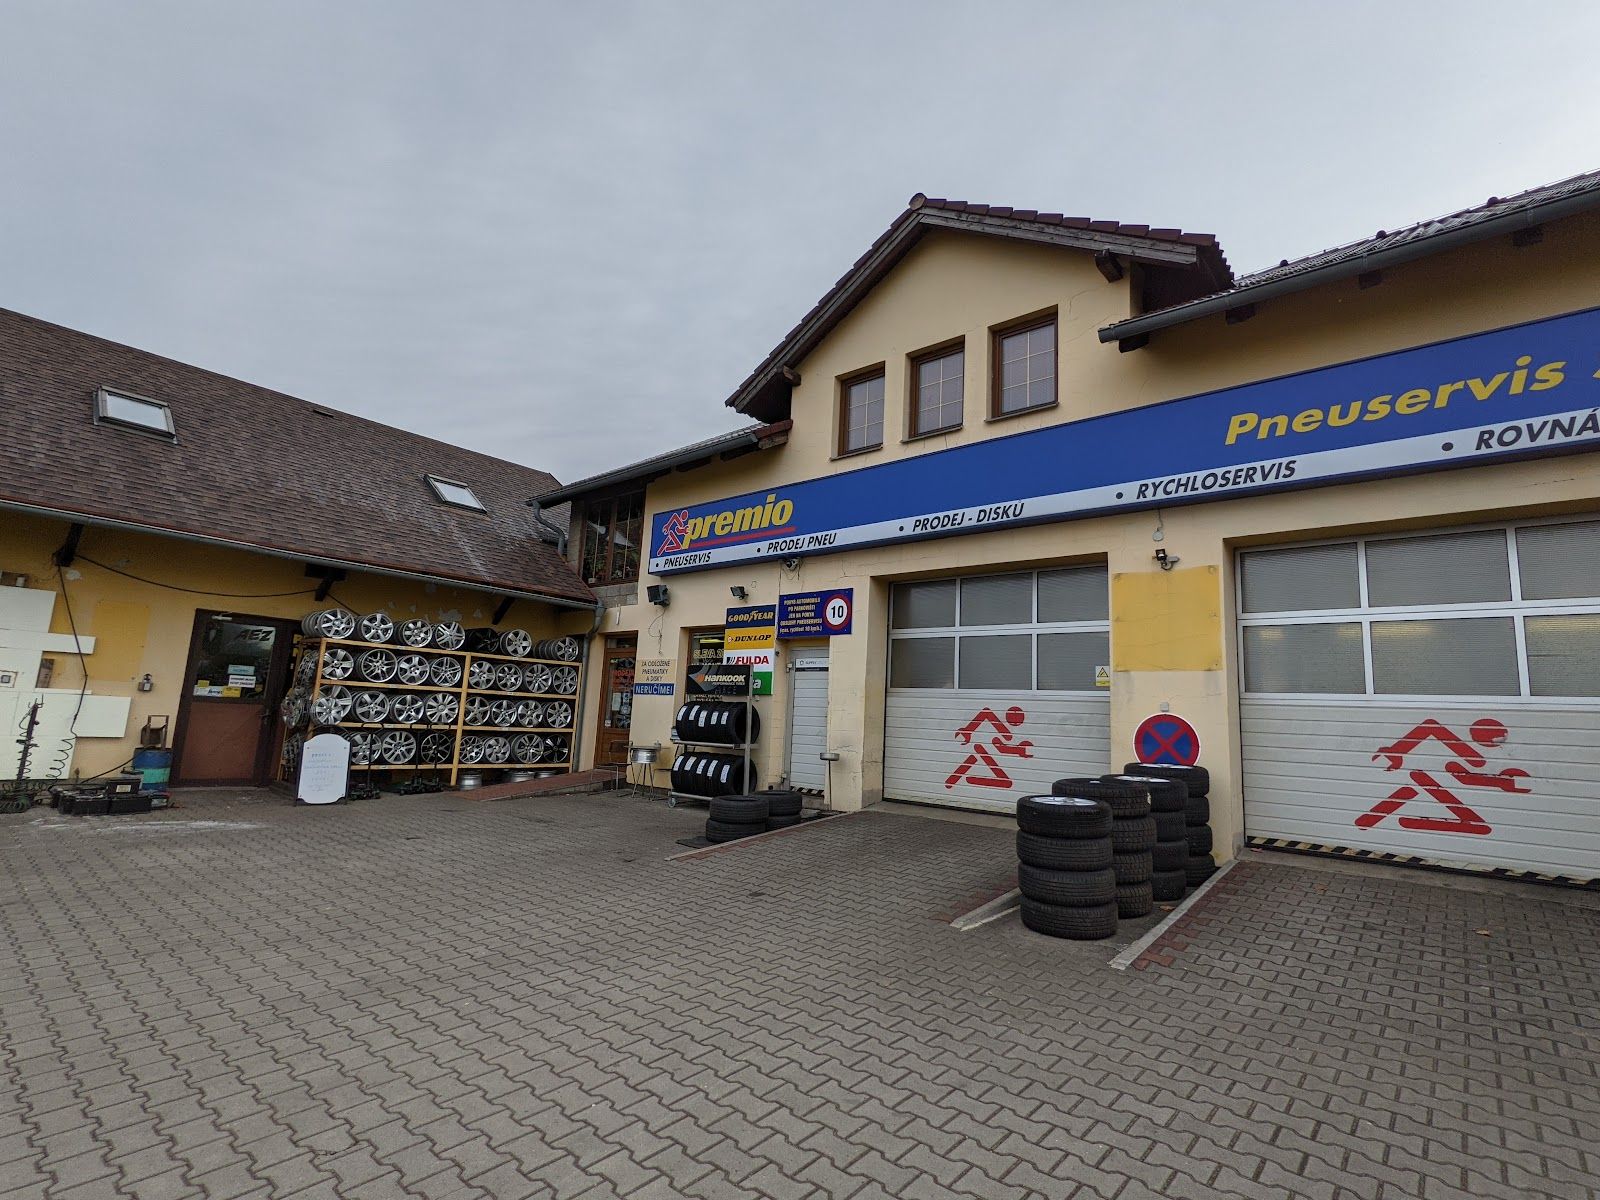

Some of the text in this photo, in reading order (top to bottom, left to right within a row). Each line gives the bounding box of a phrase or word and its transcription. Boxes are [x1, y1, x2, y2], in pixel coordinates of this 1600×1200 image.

[1224, 355, 1567, 445] Pneuservis
[1475, 408, 1600, 451] ROVNÁ
[1136, 460, 1296, 500] RYCHLOSERVIS
[682, 493, 794, 549] premio
[912, 512, 966, 532] PRODEJ
[766, 533, 837, 553] PRODEJ PNEU
[663, 552, 712, 568] PNEUSERVIS
[831, 605, 844, 618] 10
[734, 634, 771, 642] DUNLOP
[735, 655, 769, 665] FULDA
